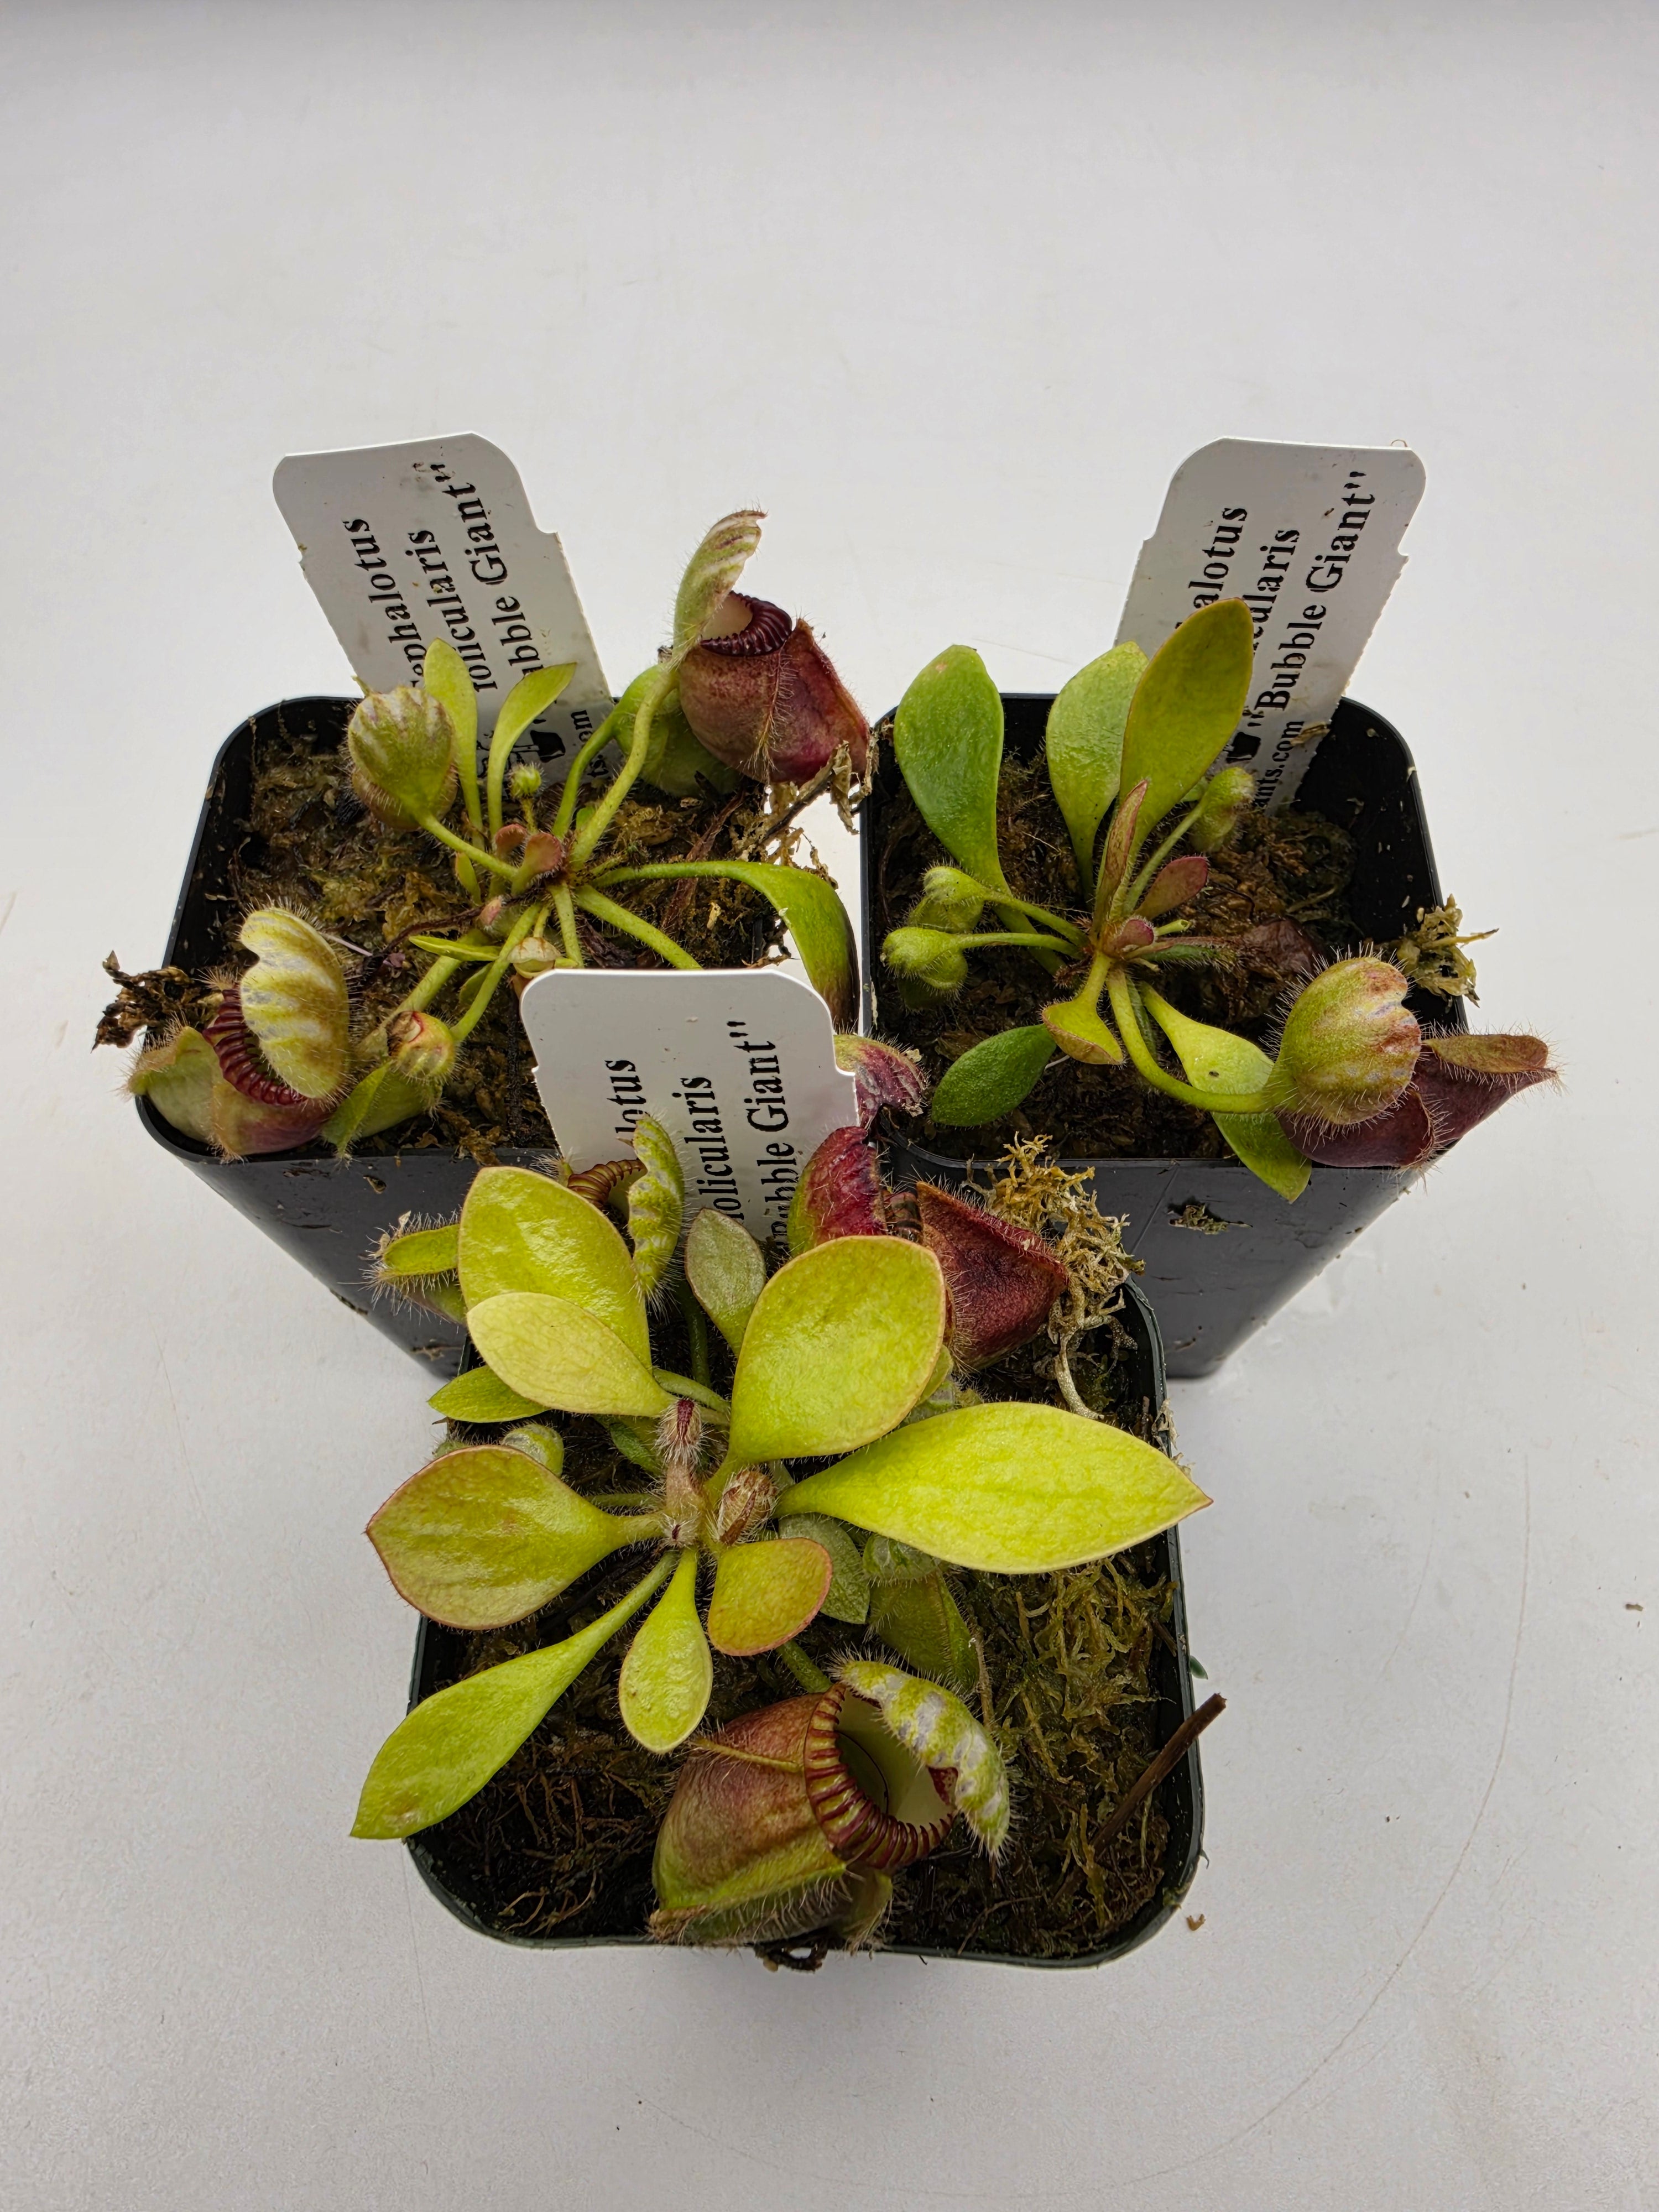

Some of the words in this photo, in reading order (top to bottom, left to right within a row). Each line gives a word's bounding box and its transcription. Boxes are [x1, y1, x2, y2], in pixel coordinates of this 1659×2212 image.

[430, 463, 508, 585] Giant"
[1175, 506, 1248, 629] alotus
[343, 518, 427, 687] ephalotus
[1247, 604, 1327, 727] "Bubble
[1306, 471, 1376, 593] Giant"
[604, 1060, 648, 1134] lotus
[727, 1021, 790, 1132] Giant"
